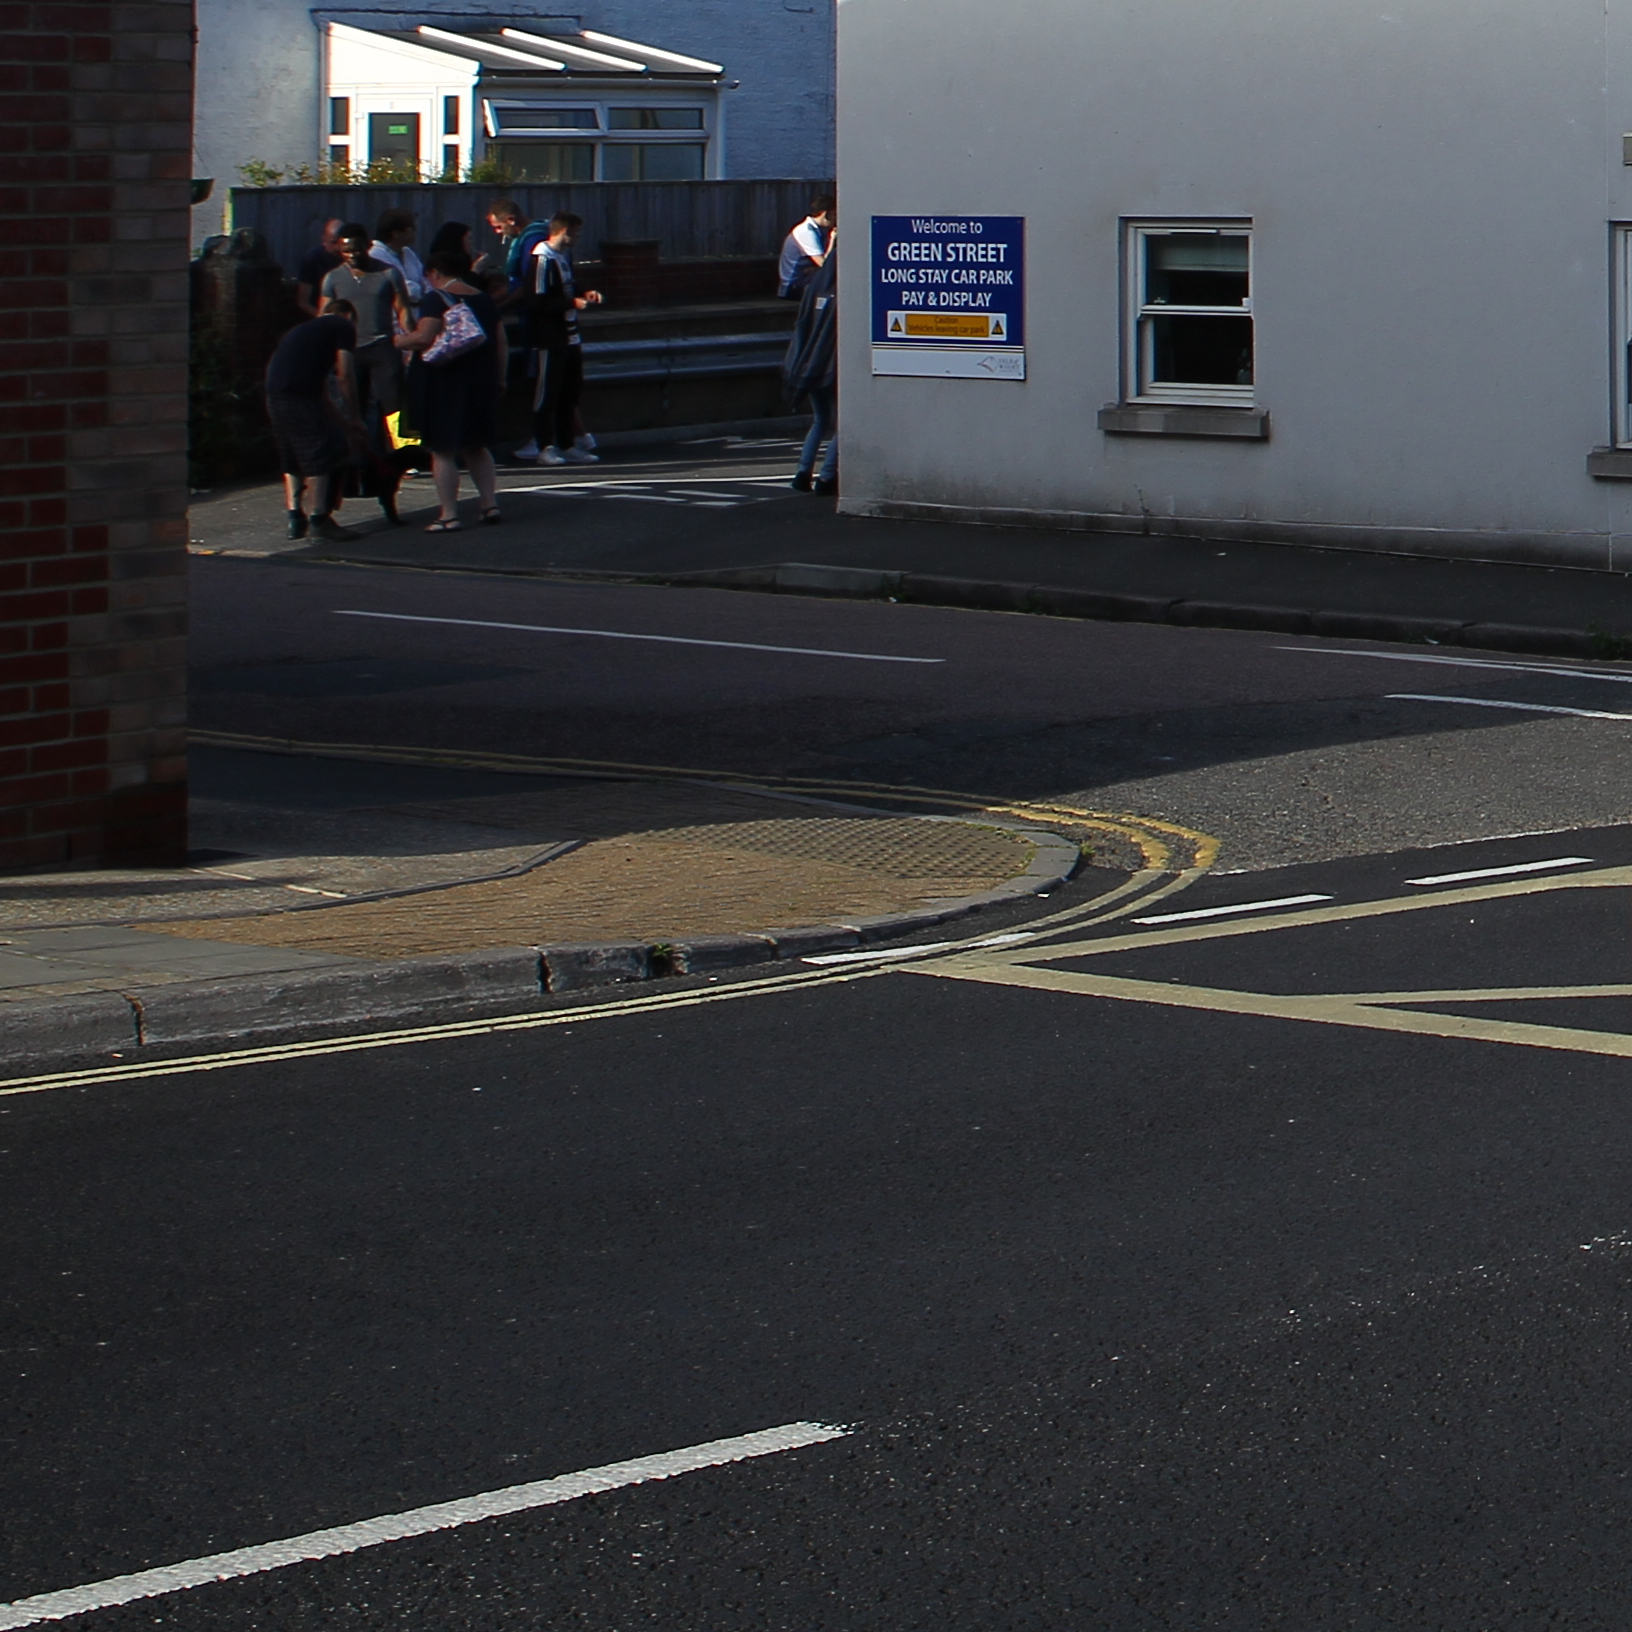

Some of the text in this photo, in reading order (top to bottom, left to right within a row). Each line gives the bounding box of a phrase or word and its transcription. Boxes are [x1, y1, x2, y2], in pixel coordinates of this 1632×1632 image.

[911, 219, 983, 234] Welcome to
[887, 242, 1008, 263] GREEN STREET
[881, 268, 1013, 285] LONG STAY CAR PARK
[901, 291, 992, 307] PAY & DISPLAY
